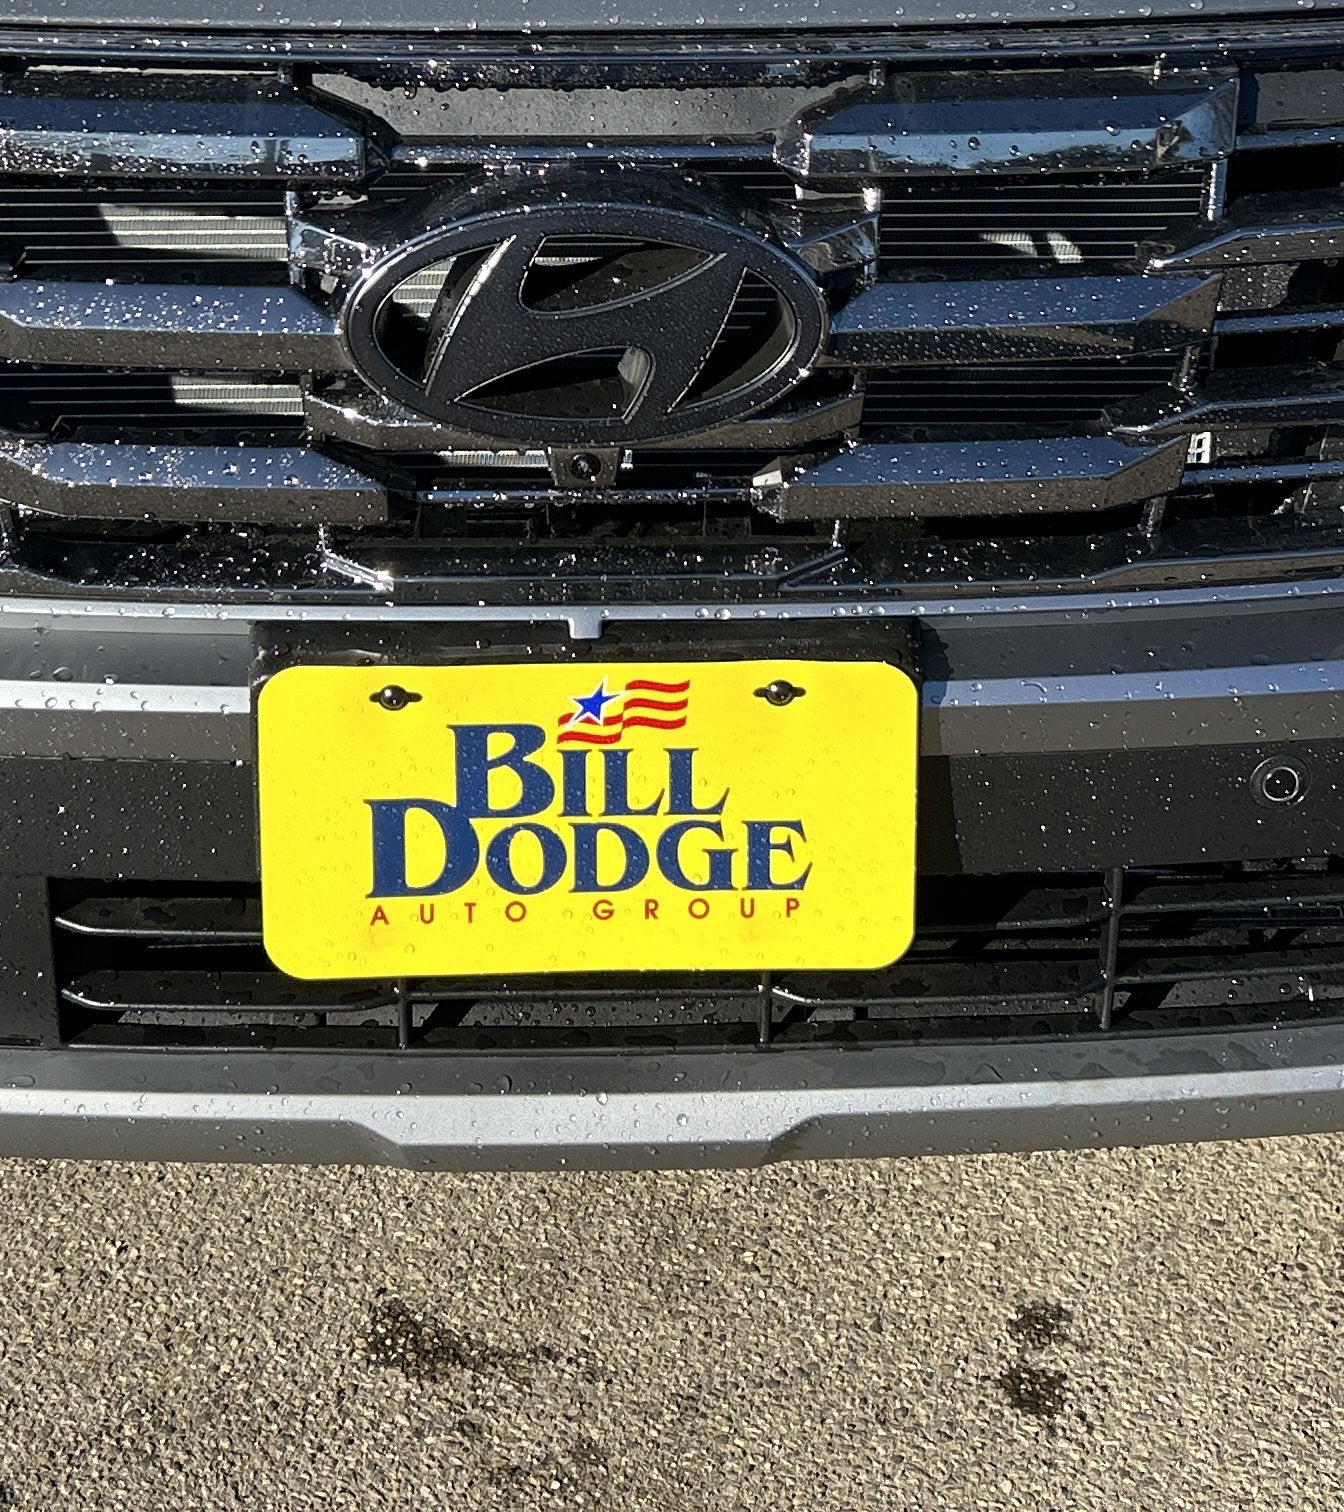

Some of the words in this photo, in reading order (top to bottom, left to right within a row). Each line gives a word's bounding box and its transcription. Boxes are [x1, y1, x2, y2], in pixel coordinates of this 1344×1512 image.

[447, 723, 731, 819] BILL
[364, 798, 813, 899] DODGE
[370, 900, 528, 926] AUTO
[592, 899, 801, 922] GROUP
